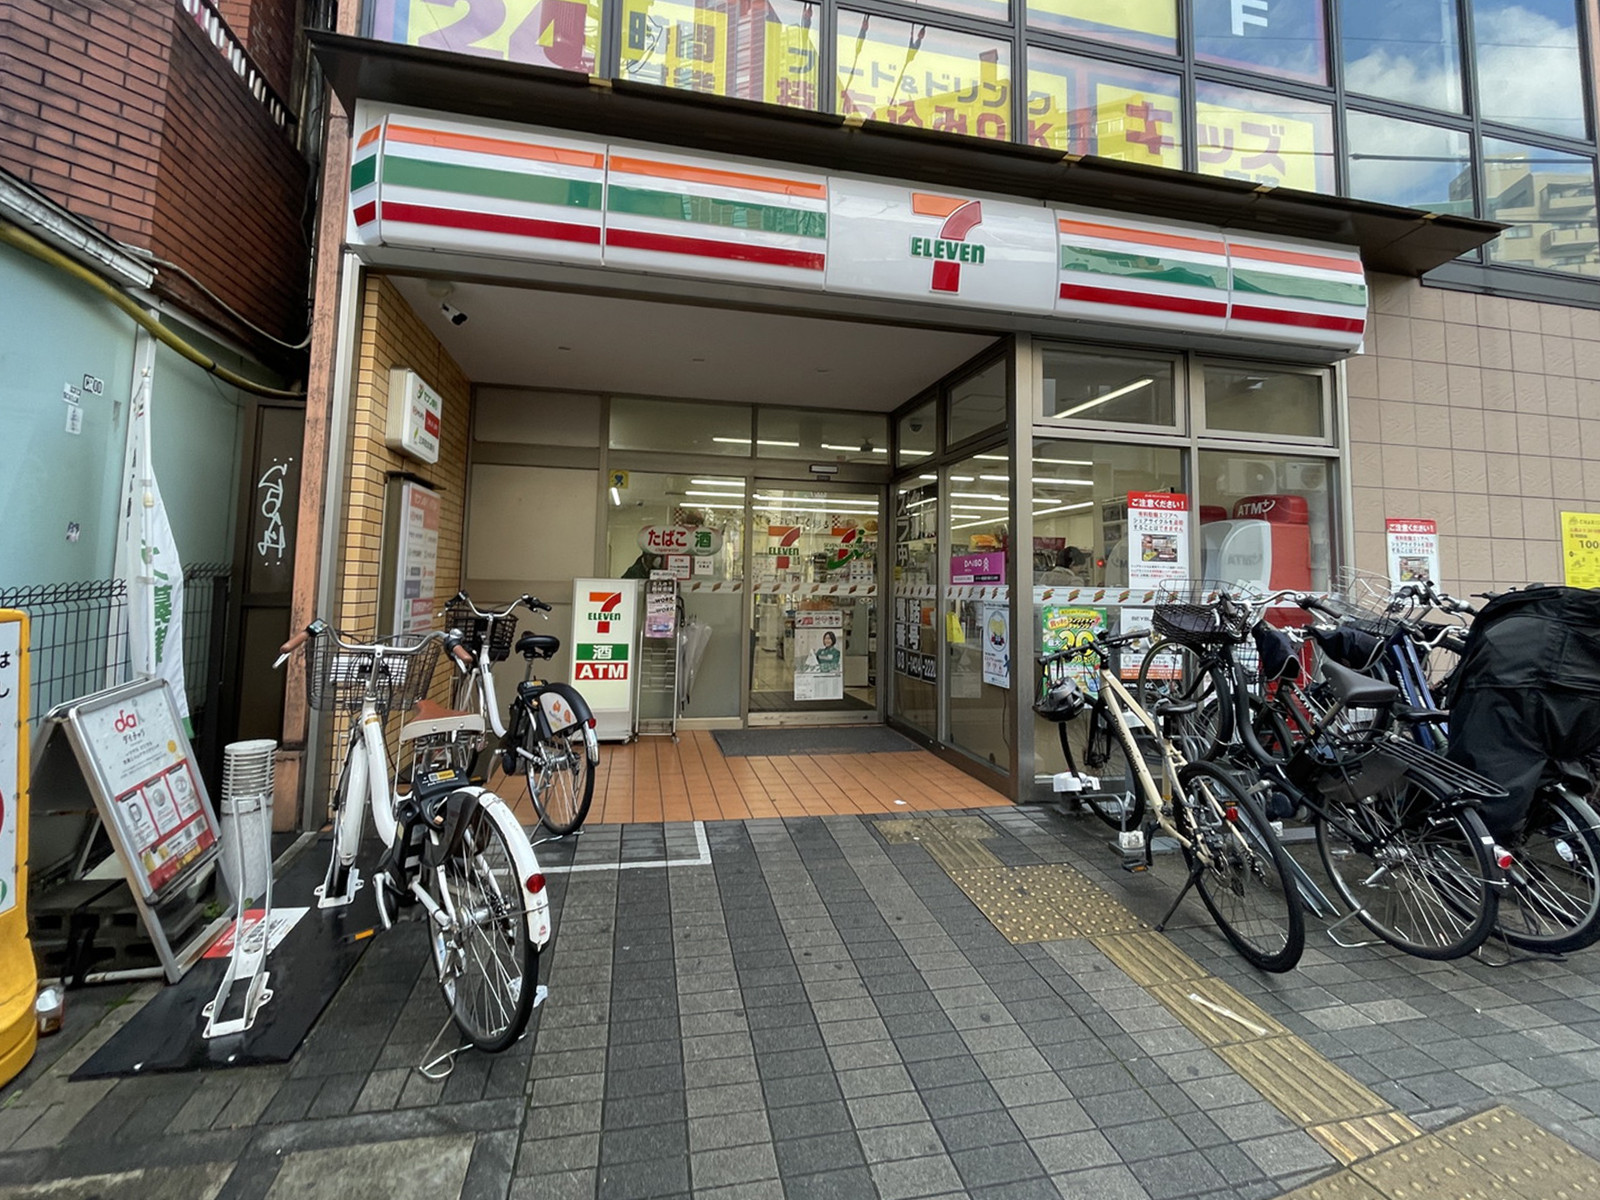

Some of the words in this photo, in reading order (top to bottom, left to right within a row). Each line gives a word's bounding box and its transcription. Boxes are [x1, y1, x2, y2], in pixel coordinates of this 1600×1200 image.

[1126, 101, 1286, 176] キッズ
[912, 192, 983, 292] 7
[648, 529, 687, 547] たばこ
[695, 531, 711, 548] 酒
[964, 558, 983, 568] DAISO
[589, 592, 622, 633] 7
[592, 645, 613, 660] 酒
[579, 663, 624, 679] ATM
